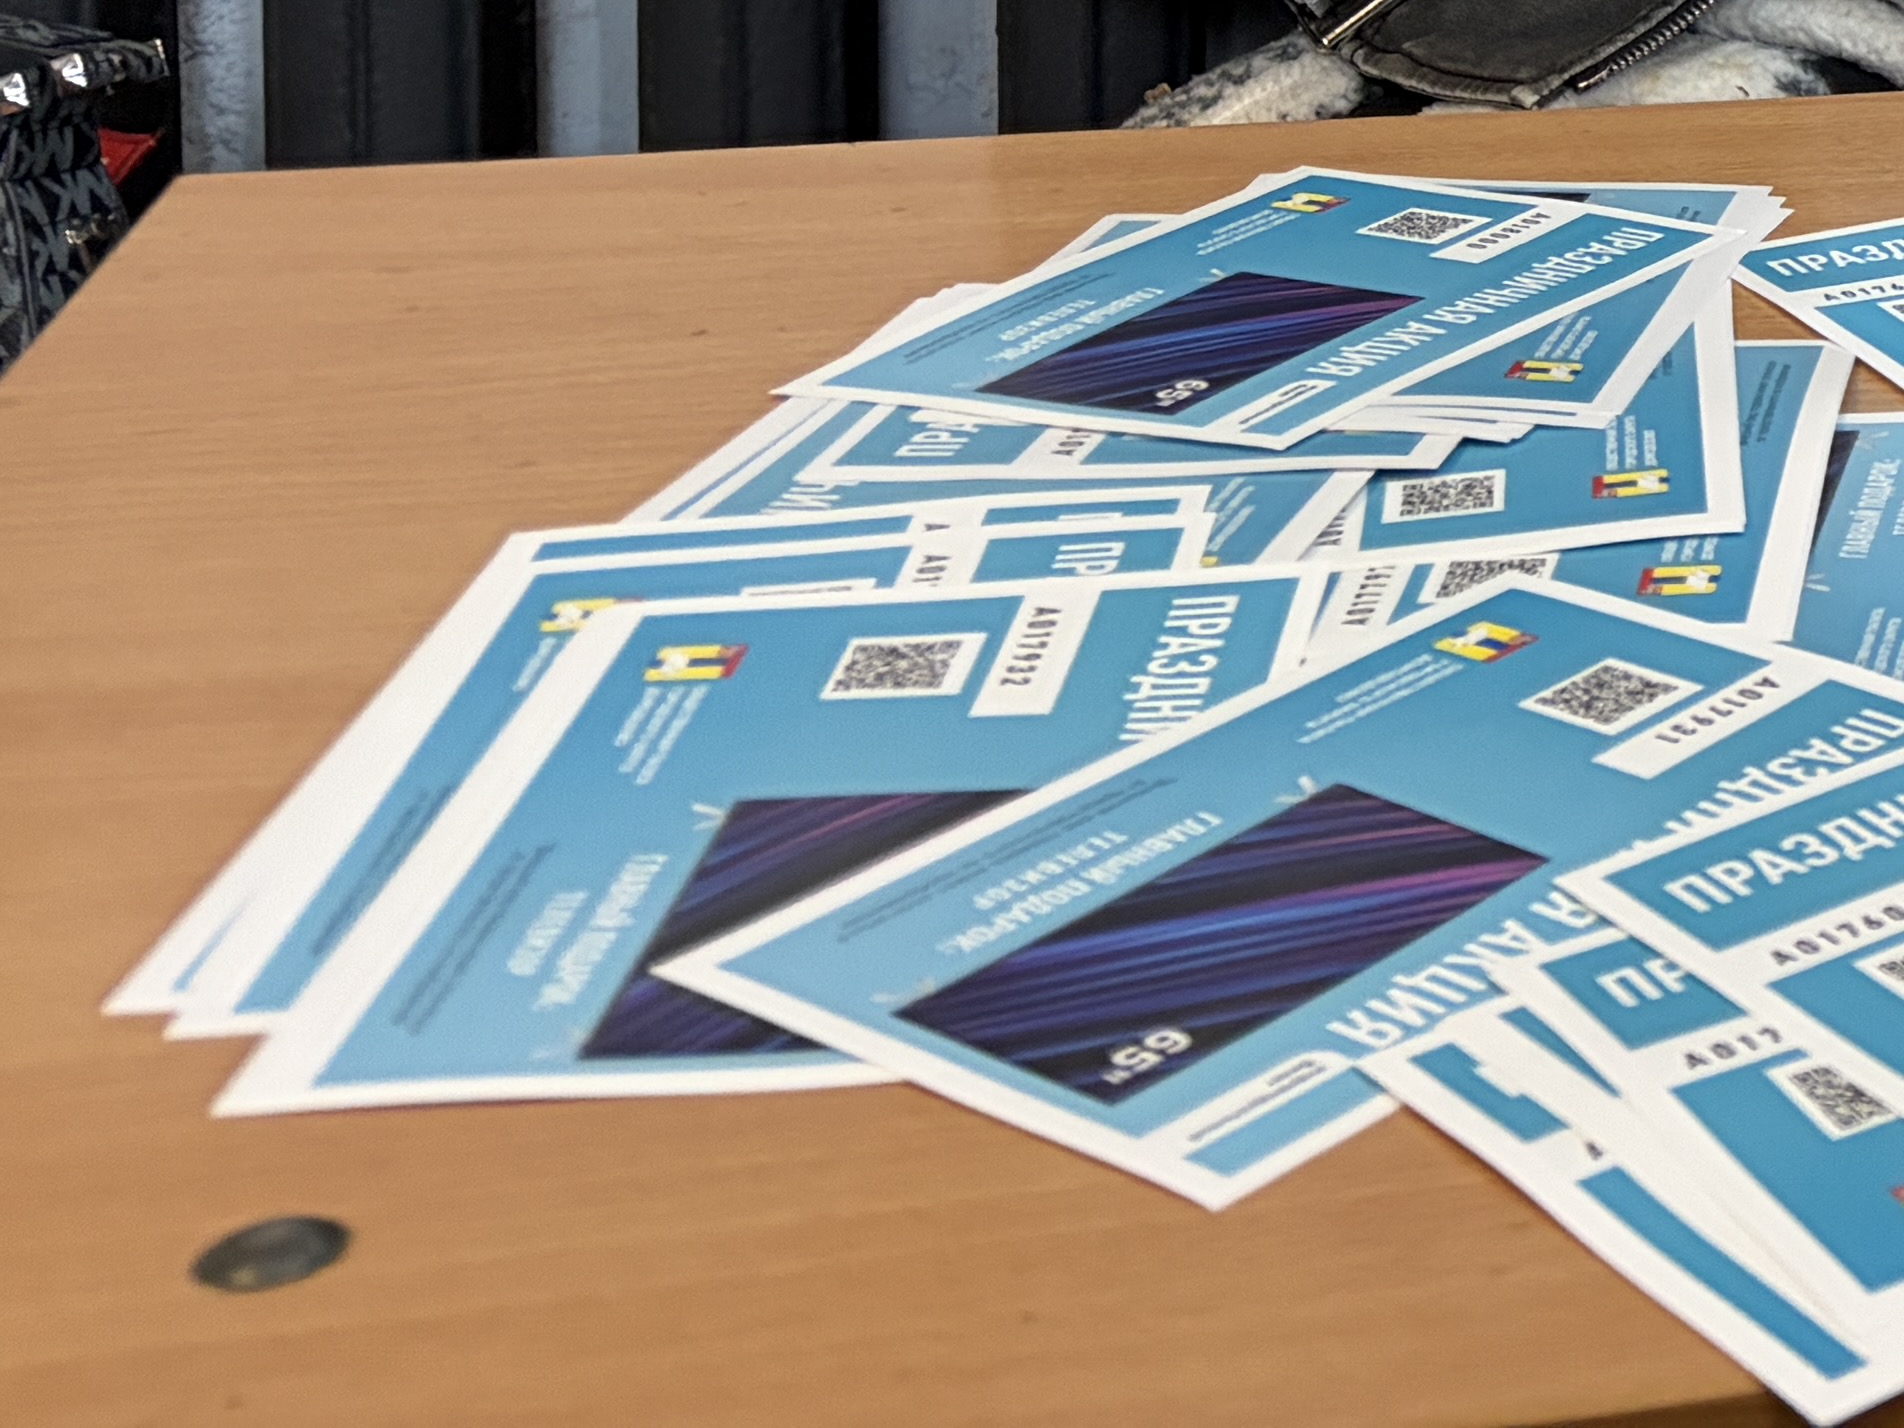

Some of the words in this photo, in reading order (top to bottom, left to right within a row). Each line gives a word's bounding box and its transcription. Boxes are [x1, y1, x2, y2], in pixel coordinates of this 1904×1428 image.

[1426, 227, 1666, 325] ПРАЗДНИЧНАЯ
[1324, 310, 1434, 379] АКЦИЯ
[1324, 917, 1540, 1052] АКЦИЯ
